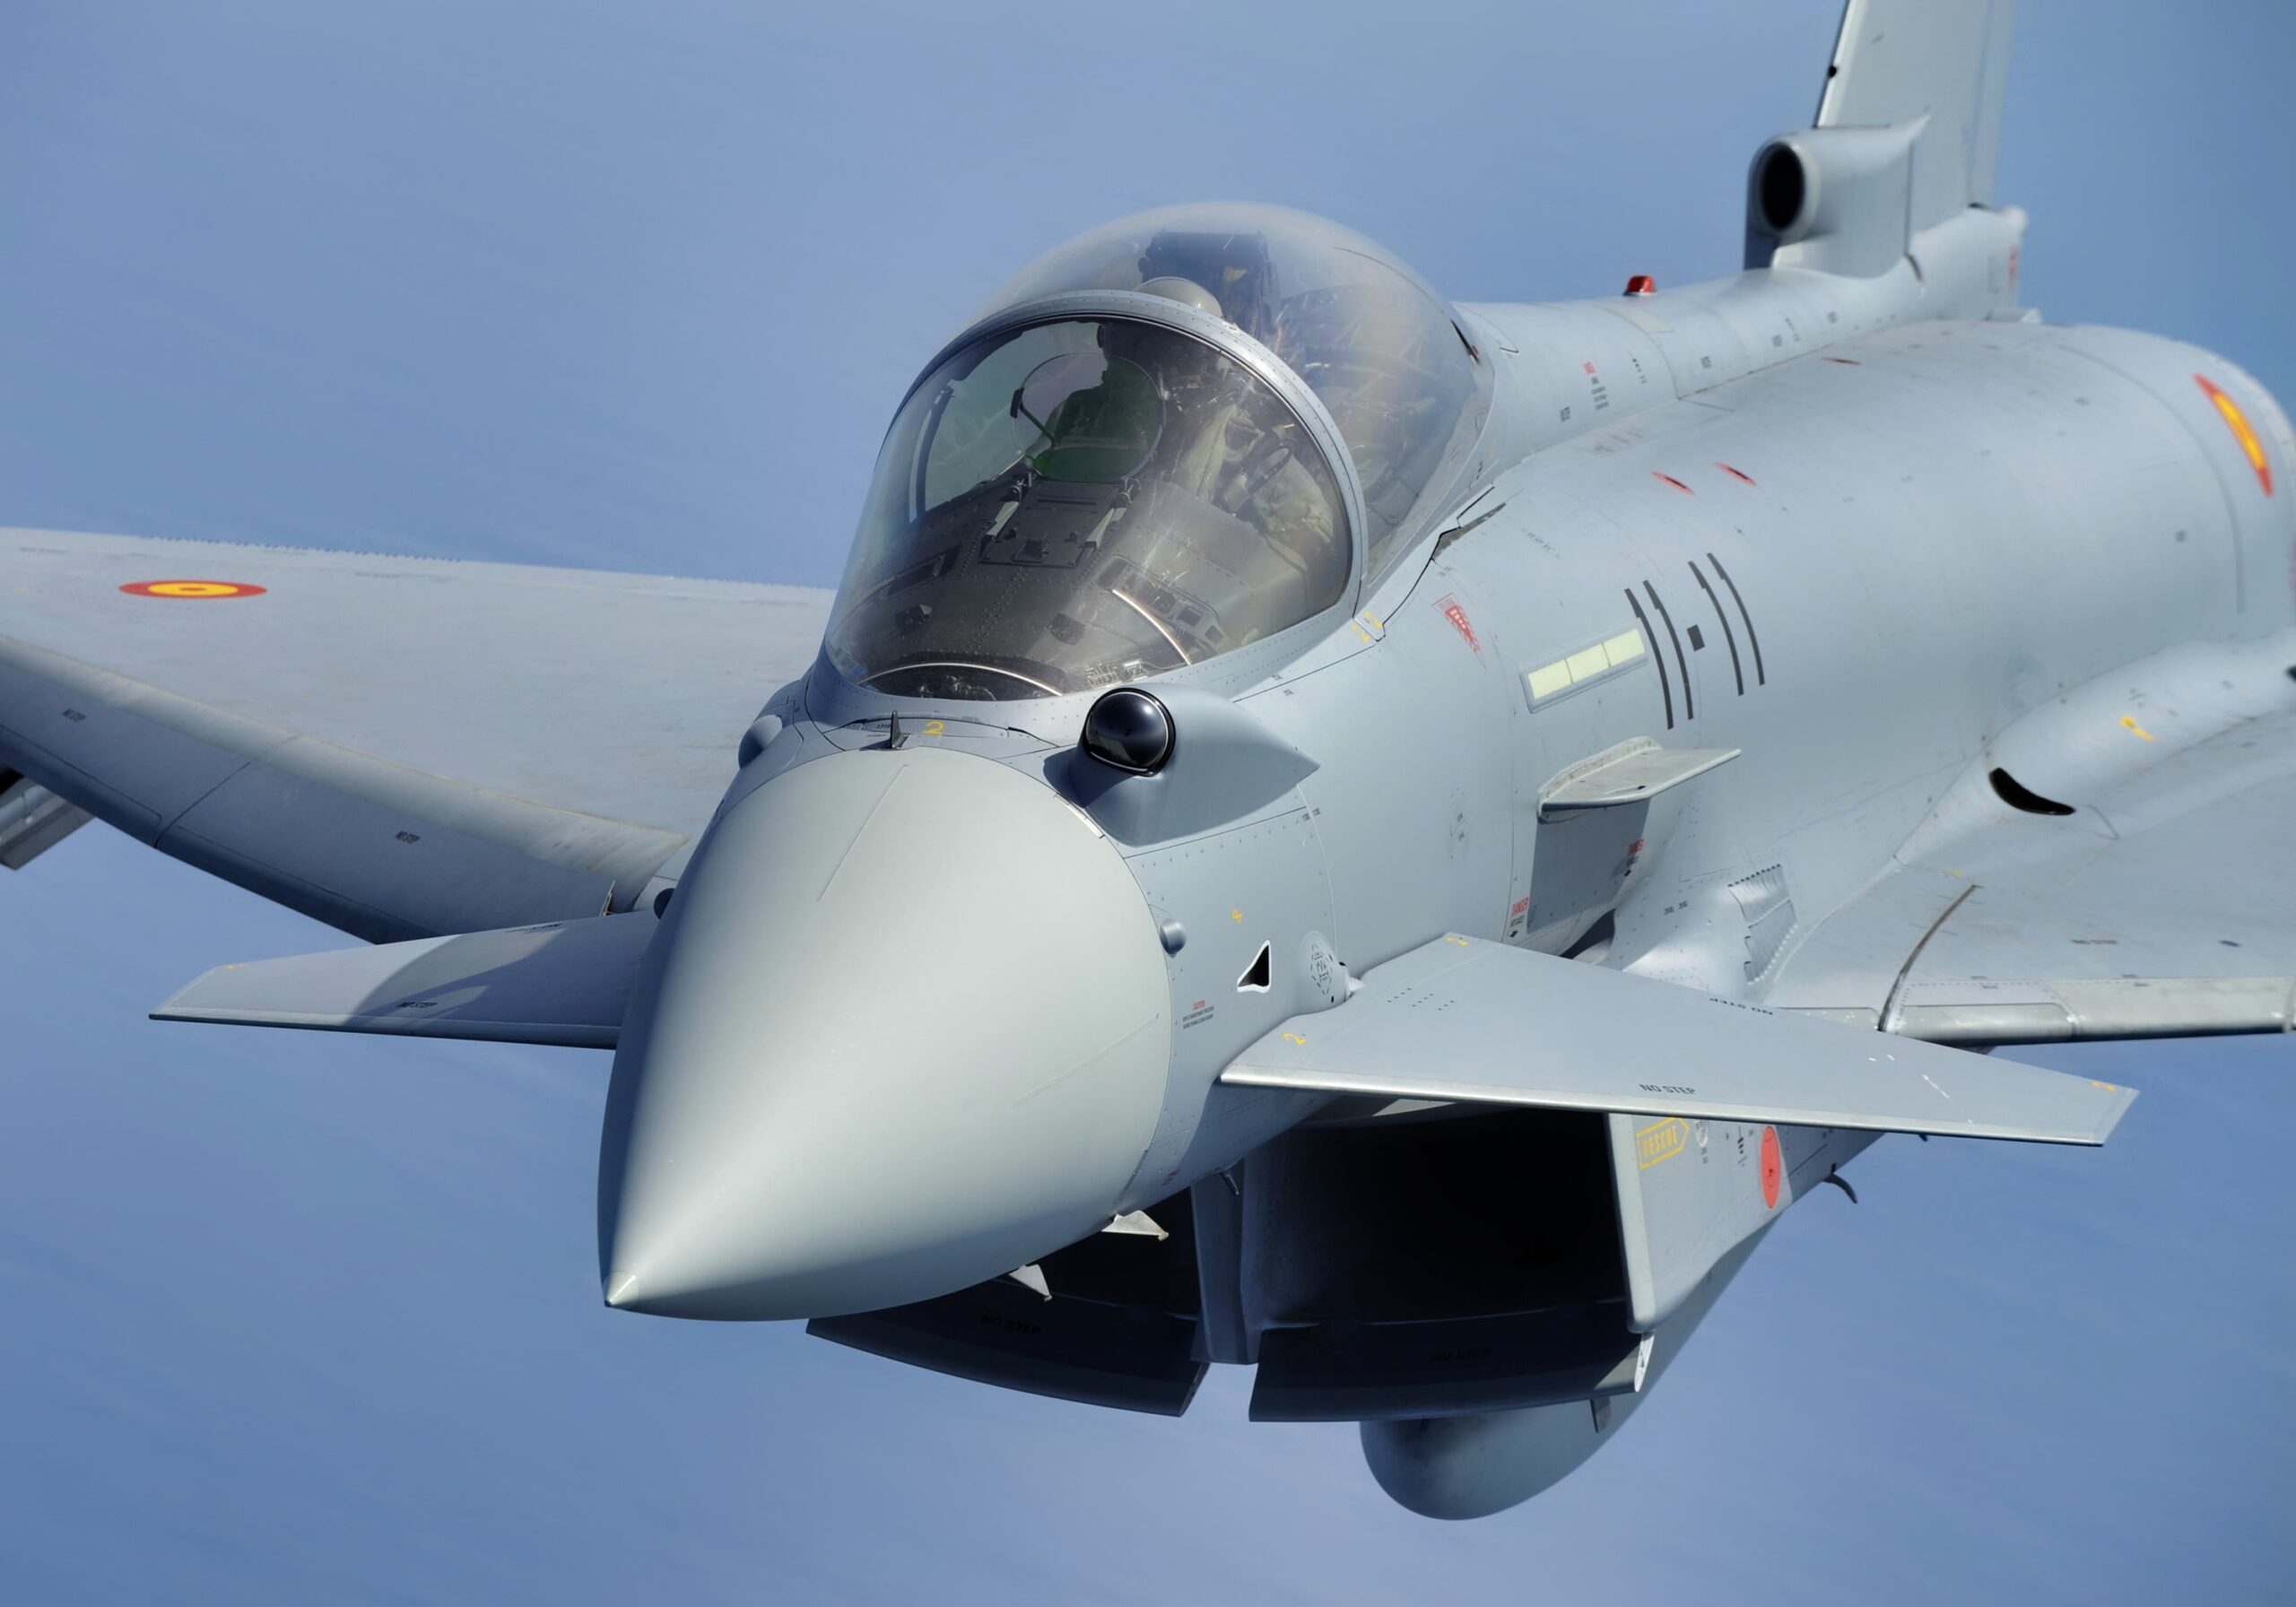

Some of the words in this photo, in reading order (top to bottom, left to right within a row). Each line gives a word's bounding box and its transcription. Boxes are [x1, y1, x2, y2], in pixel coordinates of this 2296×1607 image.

[922, 719, 944, 735] 2
[1639, 1083, 1662, 1092] NO
[1662, 1085, 1696, 1095] STEP
[1642, 1125, 1678, 1159] RESCUE
